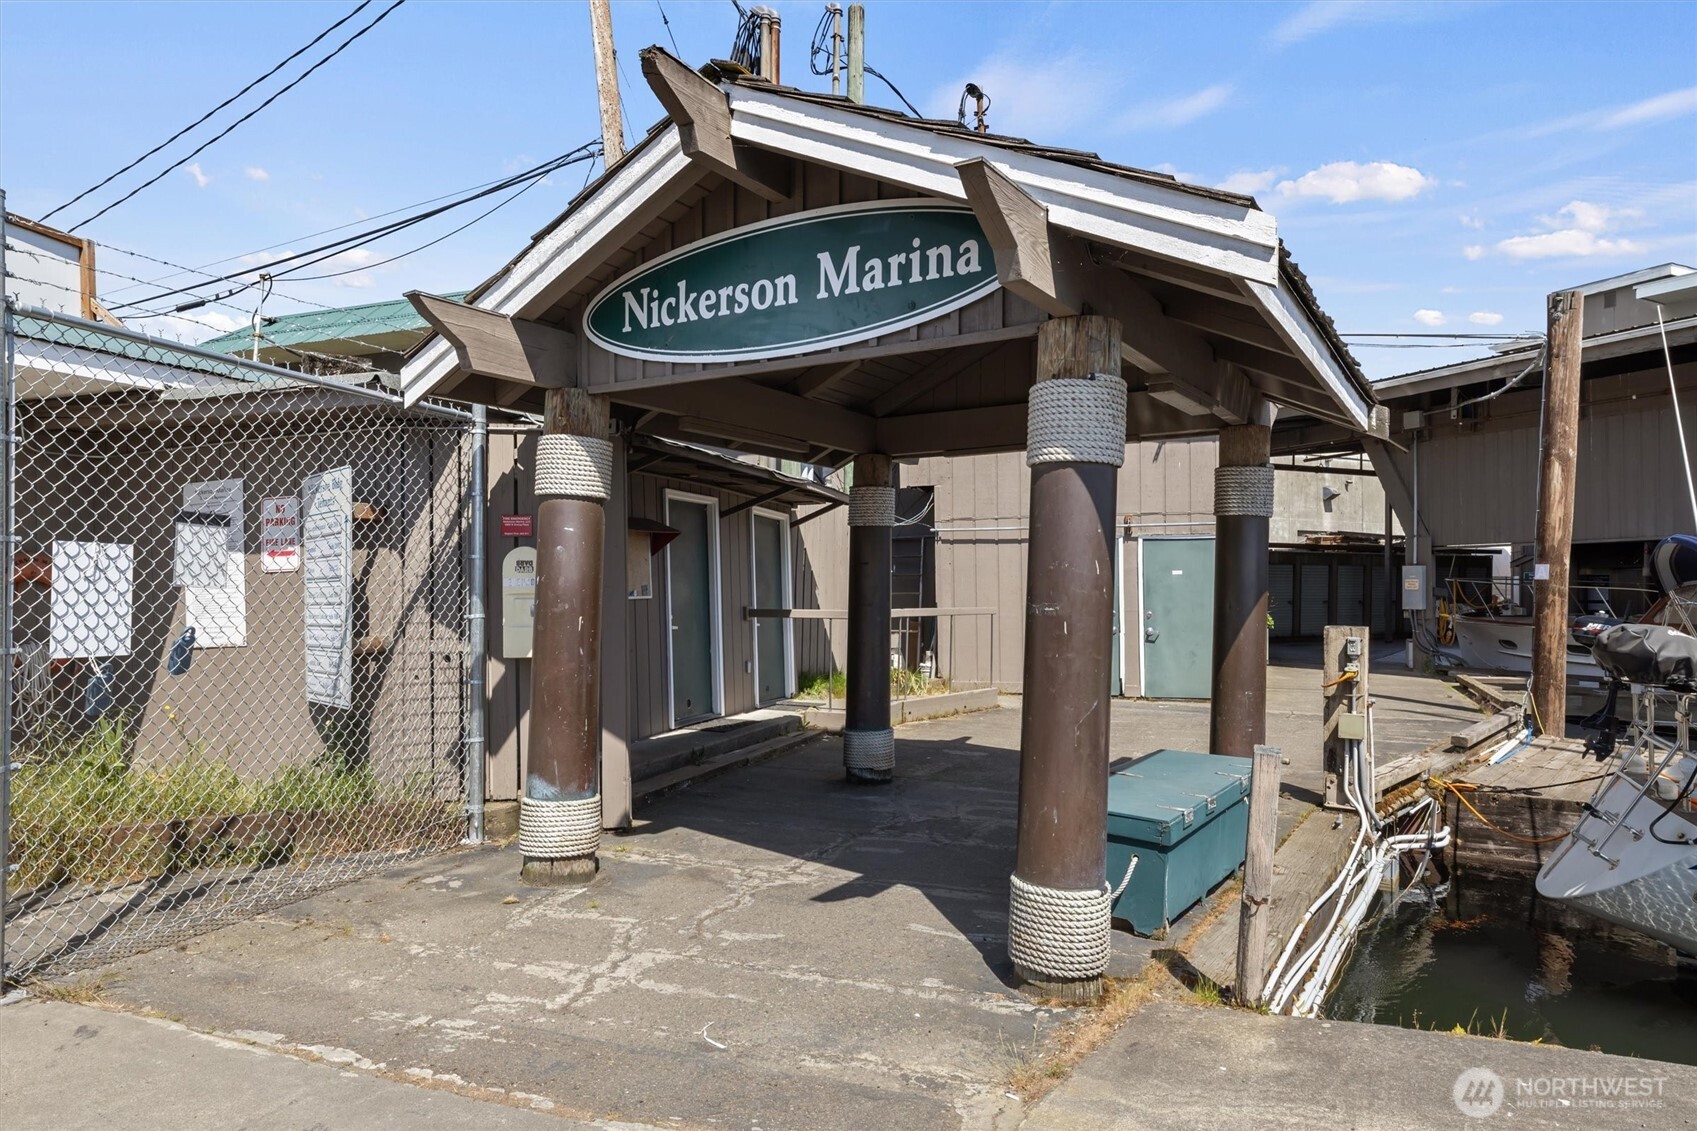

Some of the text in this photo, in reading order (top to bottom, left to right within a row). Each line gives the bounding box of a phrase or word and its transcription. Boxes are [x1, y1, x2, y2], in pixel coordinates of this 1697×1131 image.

[622, 239, 982, 333] Nickerson Marina
[275, 504, 286, 514] NO
[265, 517, 296, 527] PARKING
[265, 538, 296, 547] FIRE LANE
